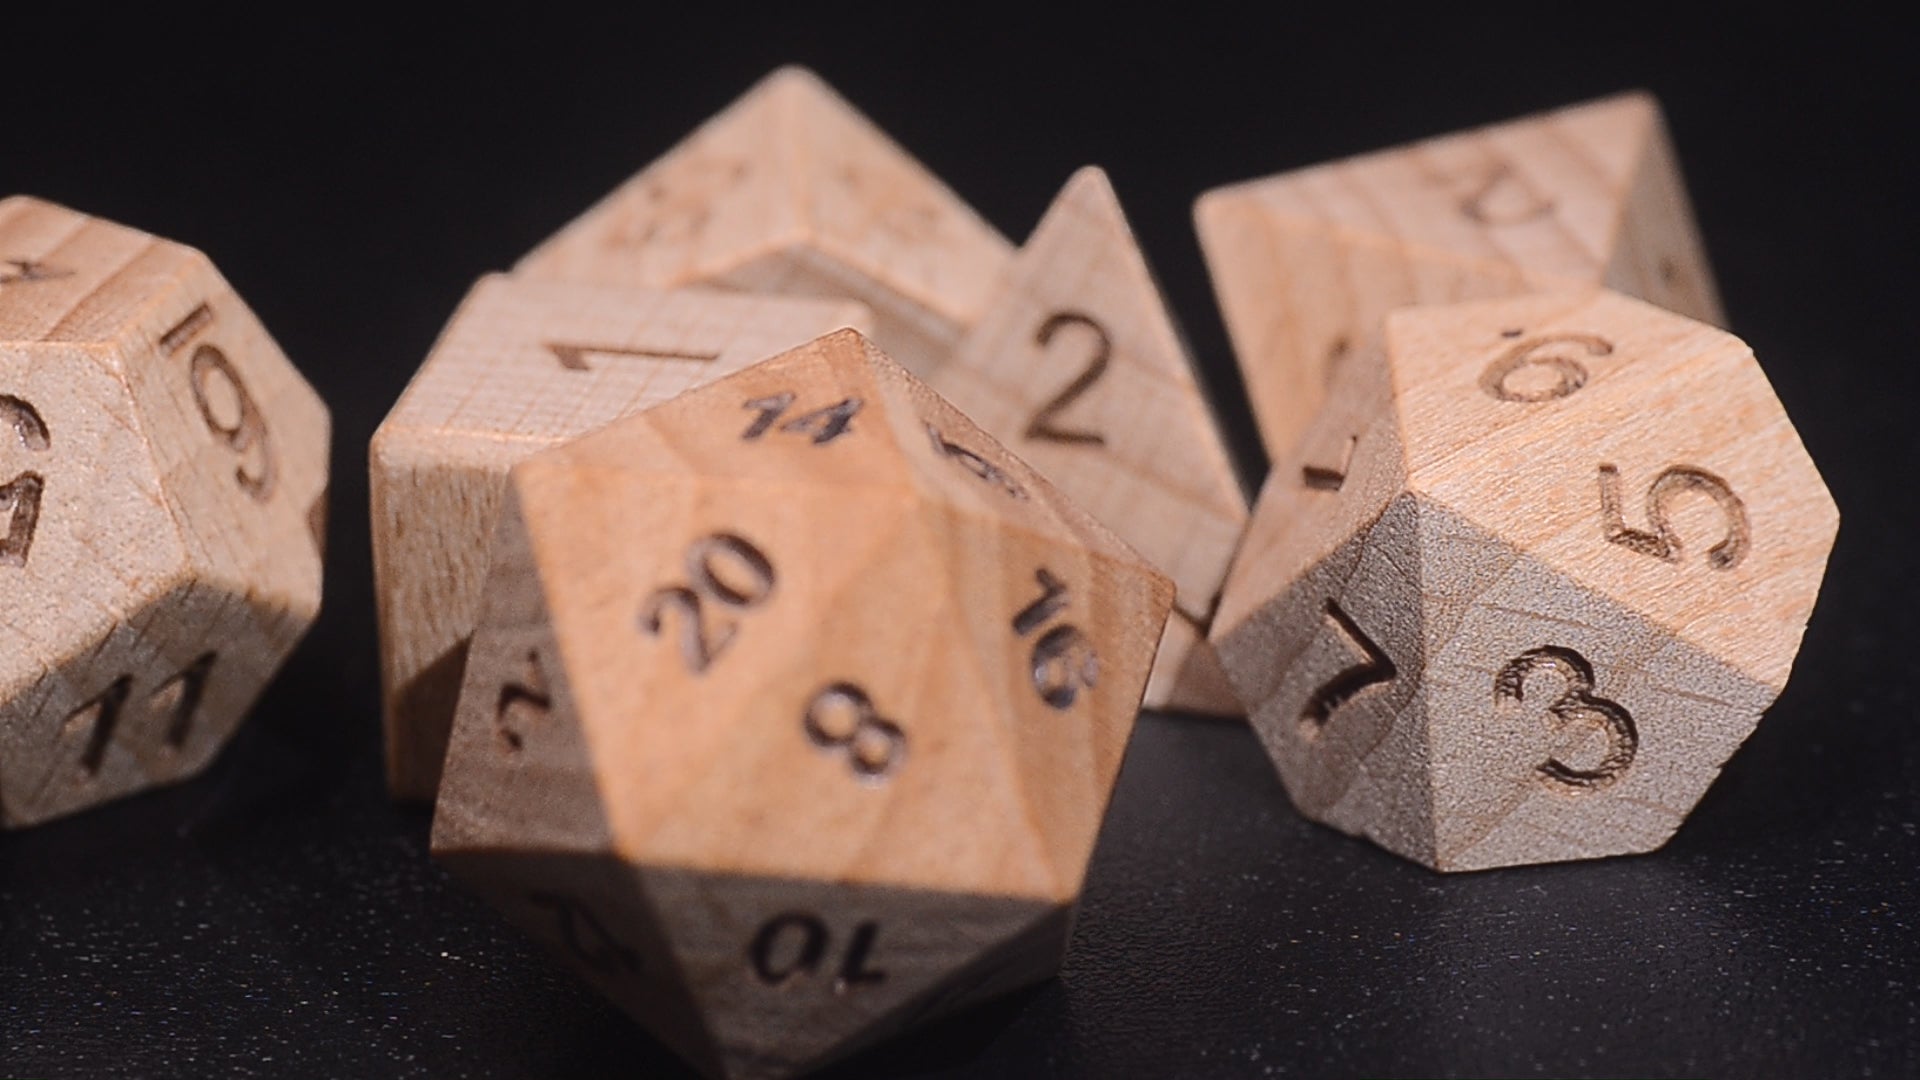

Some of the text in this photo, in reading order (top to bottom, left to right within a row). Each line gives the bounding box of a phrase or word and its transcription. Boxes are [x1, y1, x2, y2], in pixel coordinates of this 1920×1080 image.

[541, 341, 719, 372] 1
[742, 390, 865, 446] 14
[1026, 311, 1112, 446] 2
[1599, 462, 1753, 571] 5
[637, 531, 777, 675] 20
[1011, 566, 1100, 711] 16
[62, 649, 218, 778] 11
[802, 680, 909, 785] 8
[1300, 597, 1397, 739] 7
[1494, 644, 1640, 795] 3
[747, 909, 891, 989] 10
